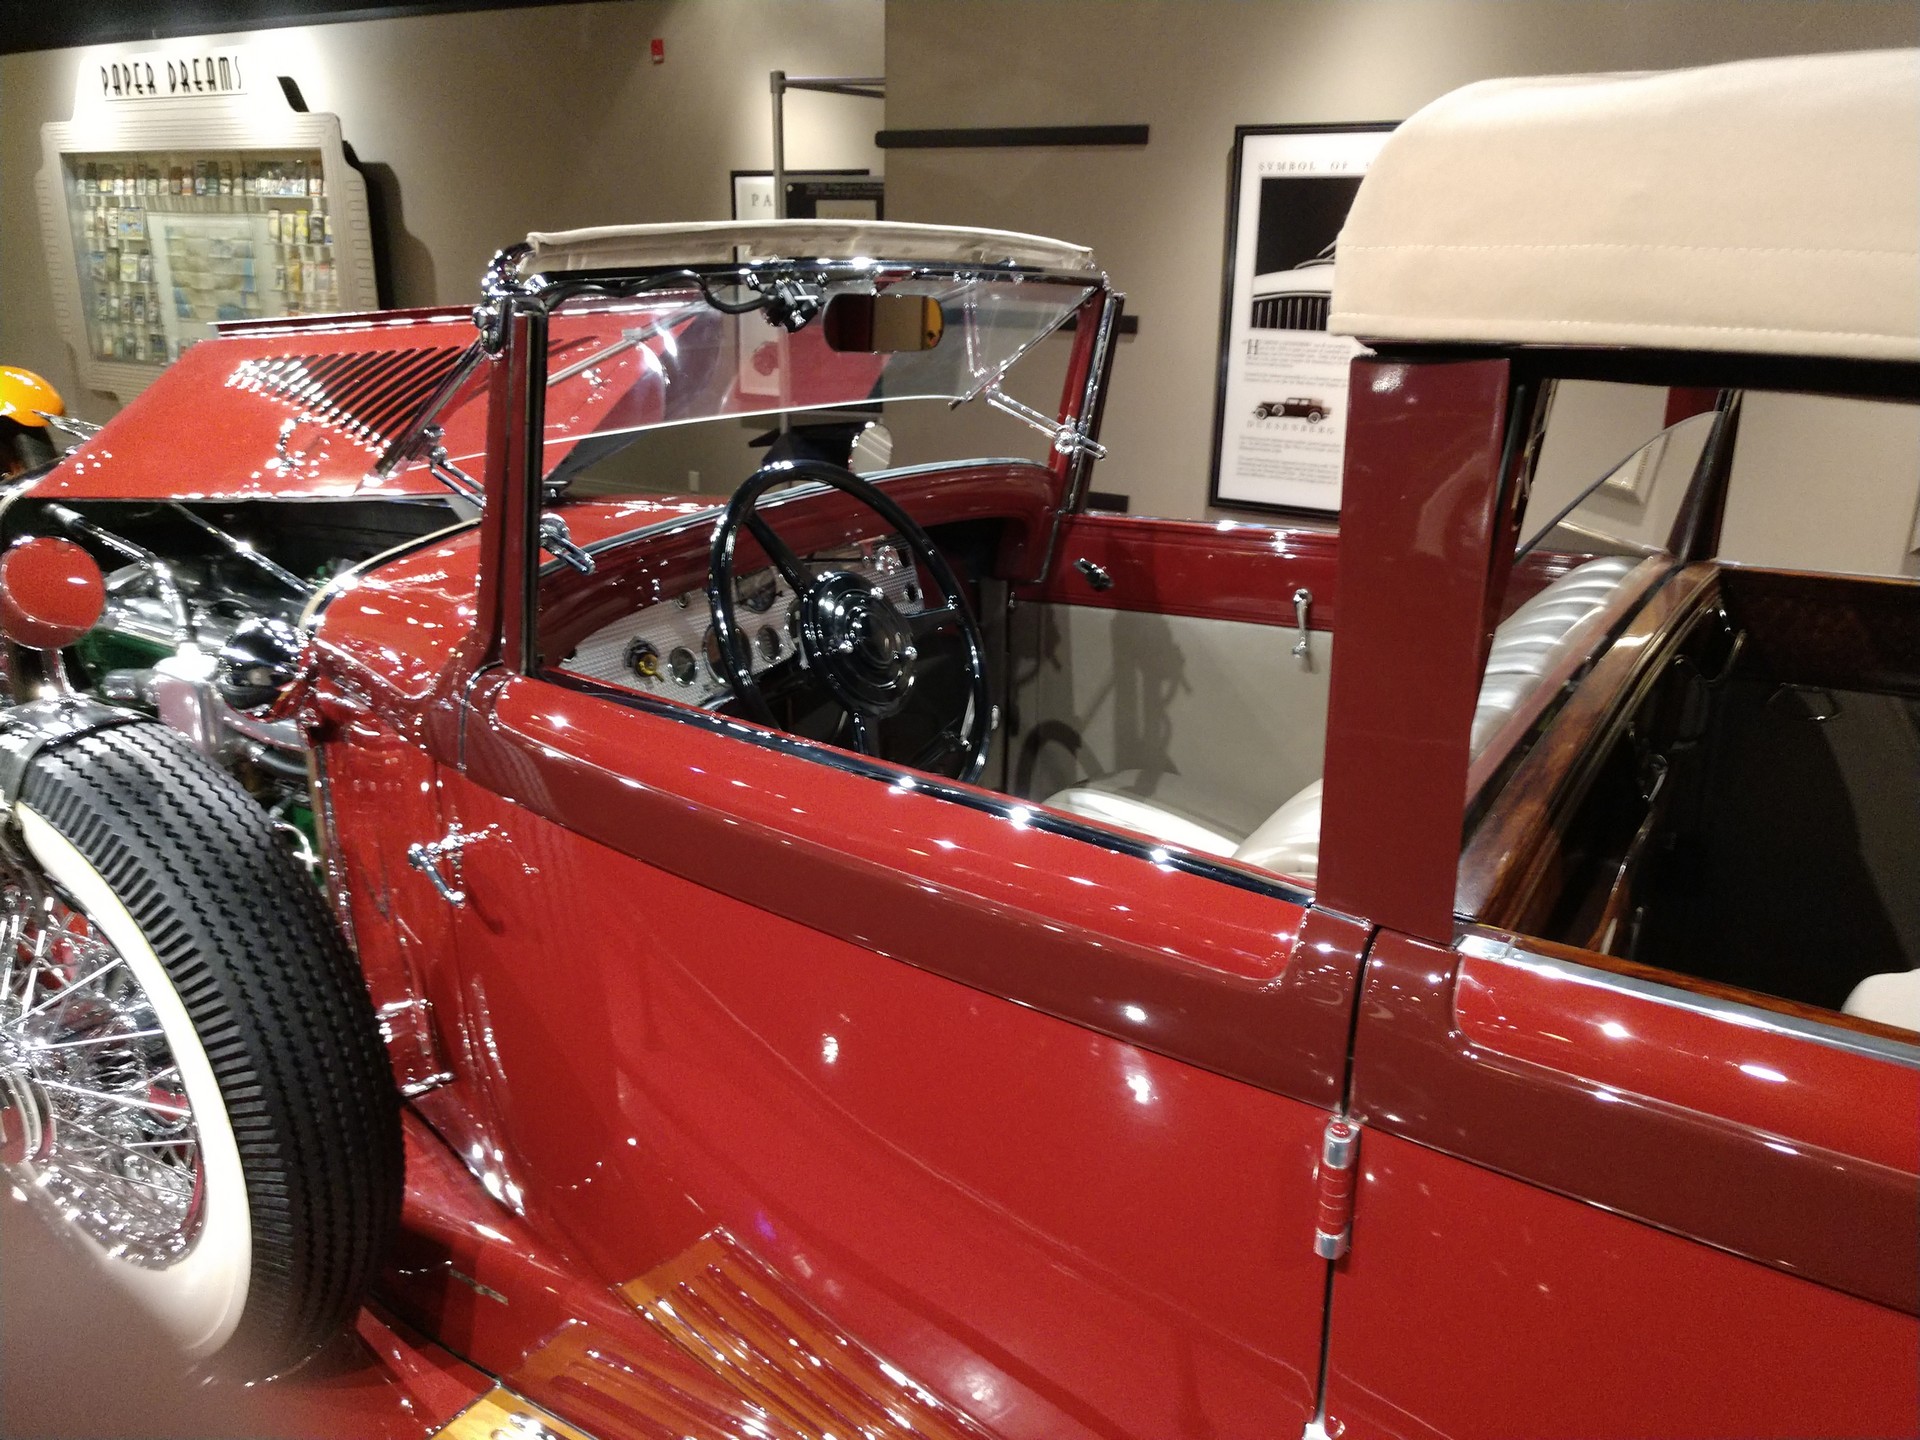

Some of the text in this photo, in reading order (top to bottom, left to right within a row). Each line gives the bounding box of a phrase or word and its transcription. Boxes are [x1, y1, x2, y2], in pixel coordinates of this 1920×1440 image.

[100, 55, 243, 97] PAPER DREAMS
[1257, 160, 1349, 172] SYMBOL OF
